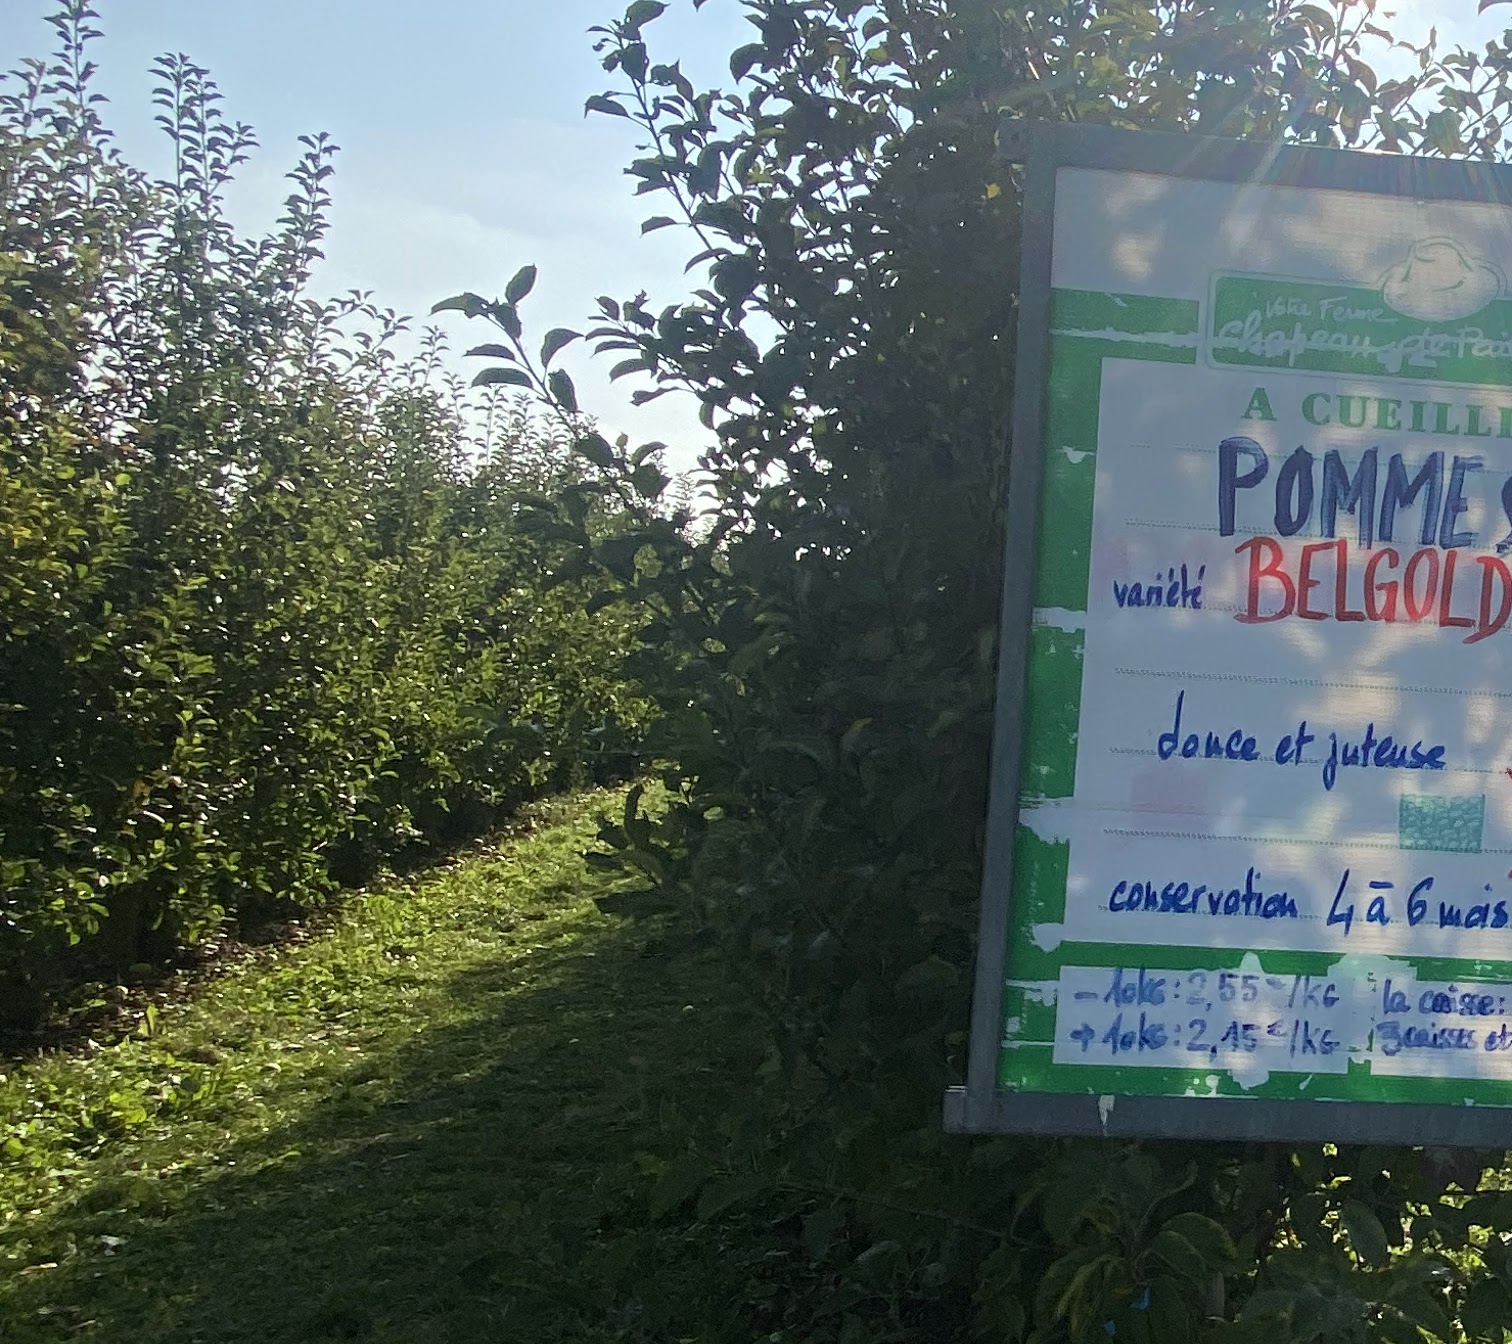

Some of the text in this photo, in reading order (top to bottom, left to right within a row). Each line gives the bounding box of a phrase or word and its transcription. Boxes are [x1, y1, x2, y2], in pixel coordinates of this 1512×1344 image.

[1319, 295, 1396, 324] Ferme
[1240, 386, 1277, 422] A
[1157, 689, 1448, 792] douce et juteuse
[1108, 866, 1300, 920] conservation
[1326, 868, 1355, 938] 4
[1406, 876, 1435, 929] 6
[1439, 882, 1511, 931] mois
